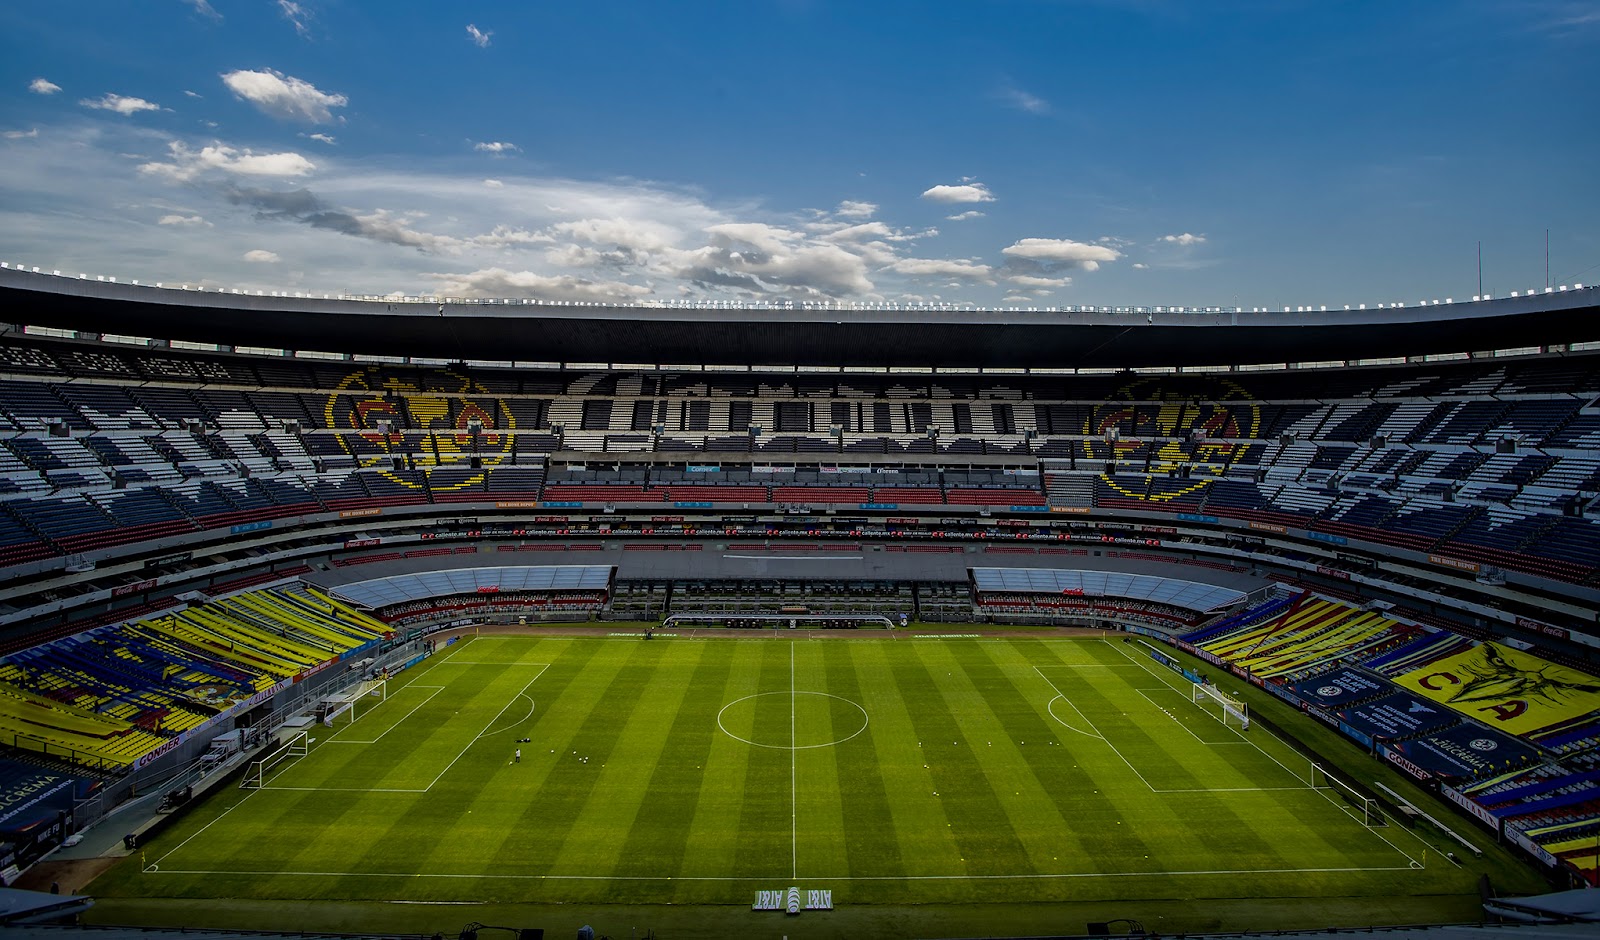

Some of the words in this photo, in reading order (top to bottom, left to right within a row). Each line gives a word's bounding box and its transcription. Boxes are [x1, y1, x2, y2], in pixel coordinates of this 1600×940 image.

[139, 736, 180, 767] GONHER
[1389, 752, 1430, 781] GONHER
[754, 890, 783, 909] AT&T
[807, 890, 832, 909] AT&T
